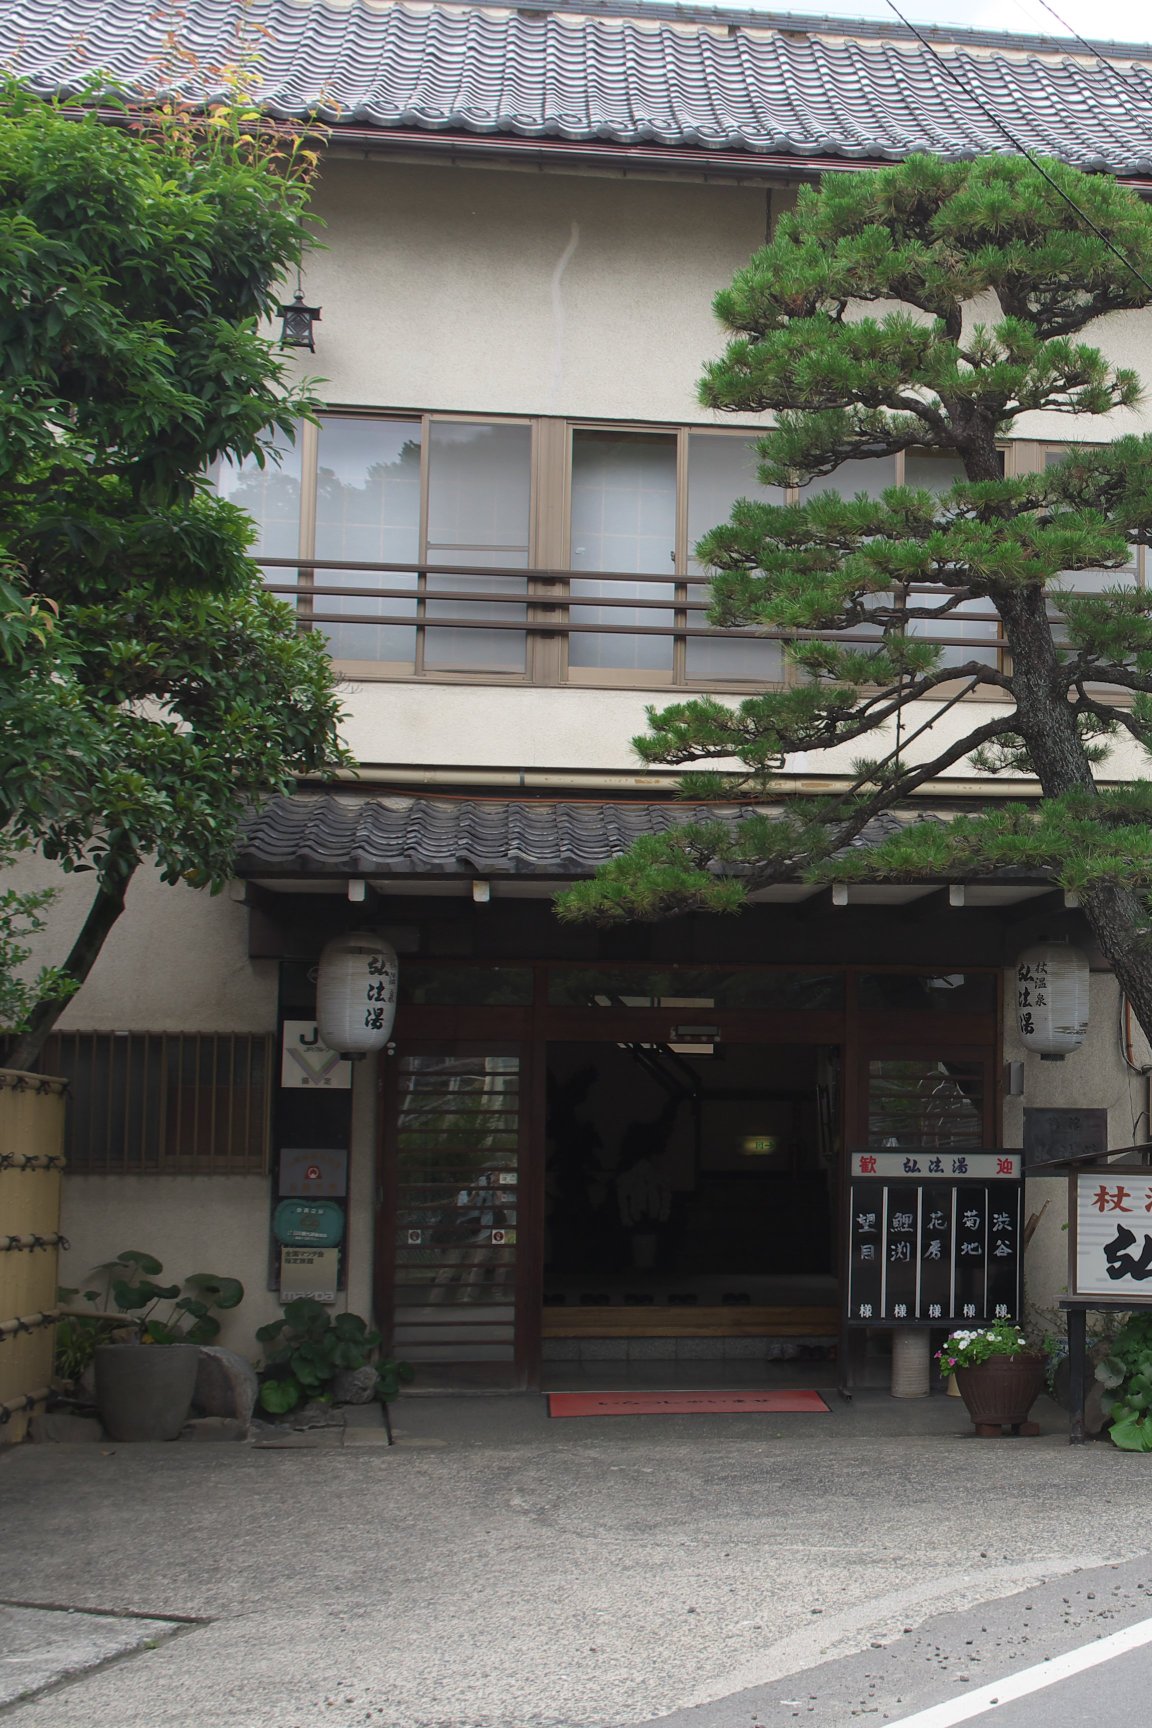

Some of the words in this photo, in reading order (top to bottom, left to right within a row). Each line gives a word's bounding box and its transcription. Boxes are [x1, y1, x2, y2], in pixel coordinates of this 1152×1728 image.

[365, 955, 389, 1030] 弘法湯
[1017, 962, 1035, 1035] 弘法湯
[1034, 960, 1048, 1007] 杖温泉
[859, 1155, 877, 1174] 歓
[902, 1156, 969, 1174] 弘法湯
[996, 1157, 1013, 1175] 迎
[924, 1210, 948, 1261] 花房
[961, 1208, 983, 1257] 菊地
[992, 1211, 1014, 1257] 渋谷
[859, 1303, 873, 1318] 様
[893, 1303, 908, 1318] 様
[928, 1303, 943, 1318] 様
[963, 1303, 977, 1318] 様
[994, 1303, 1008, 1318] 様
